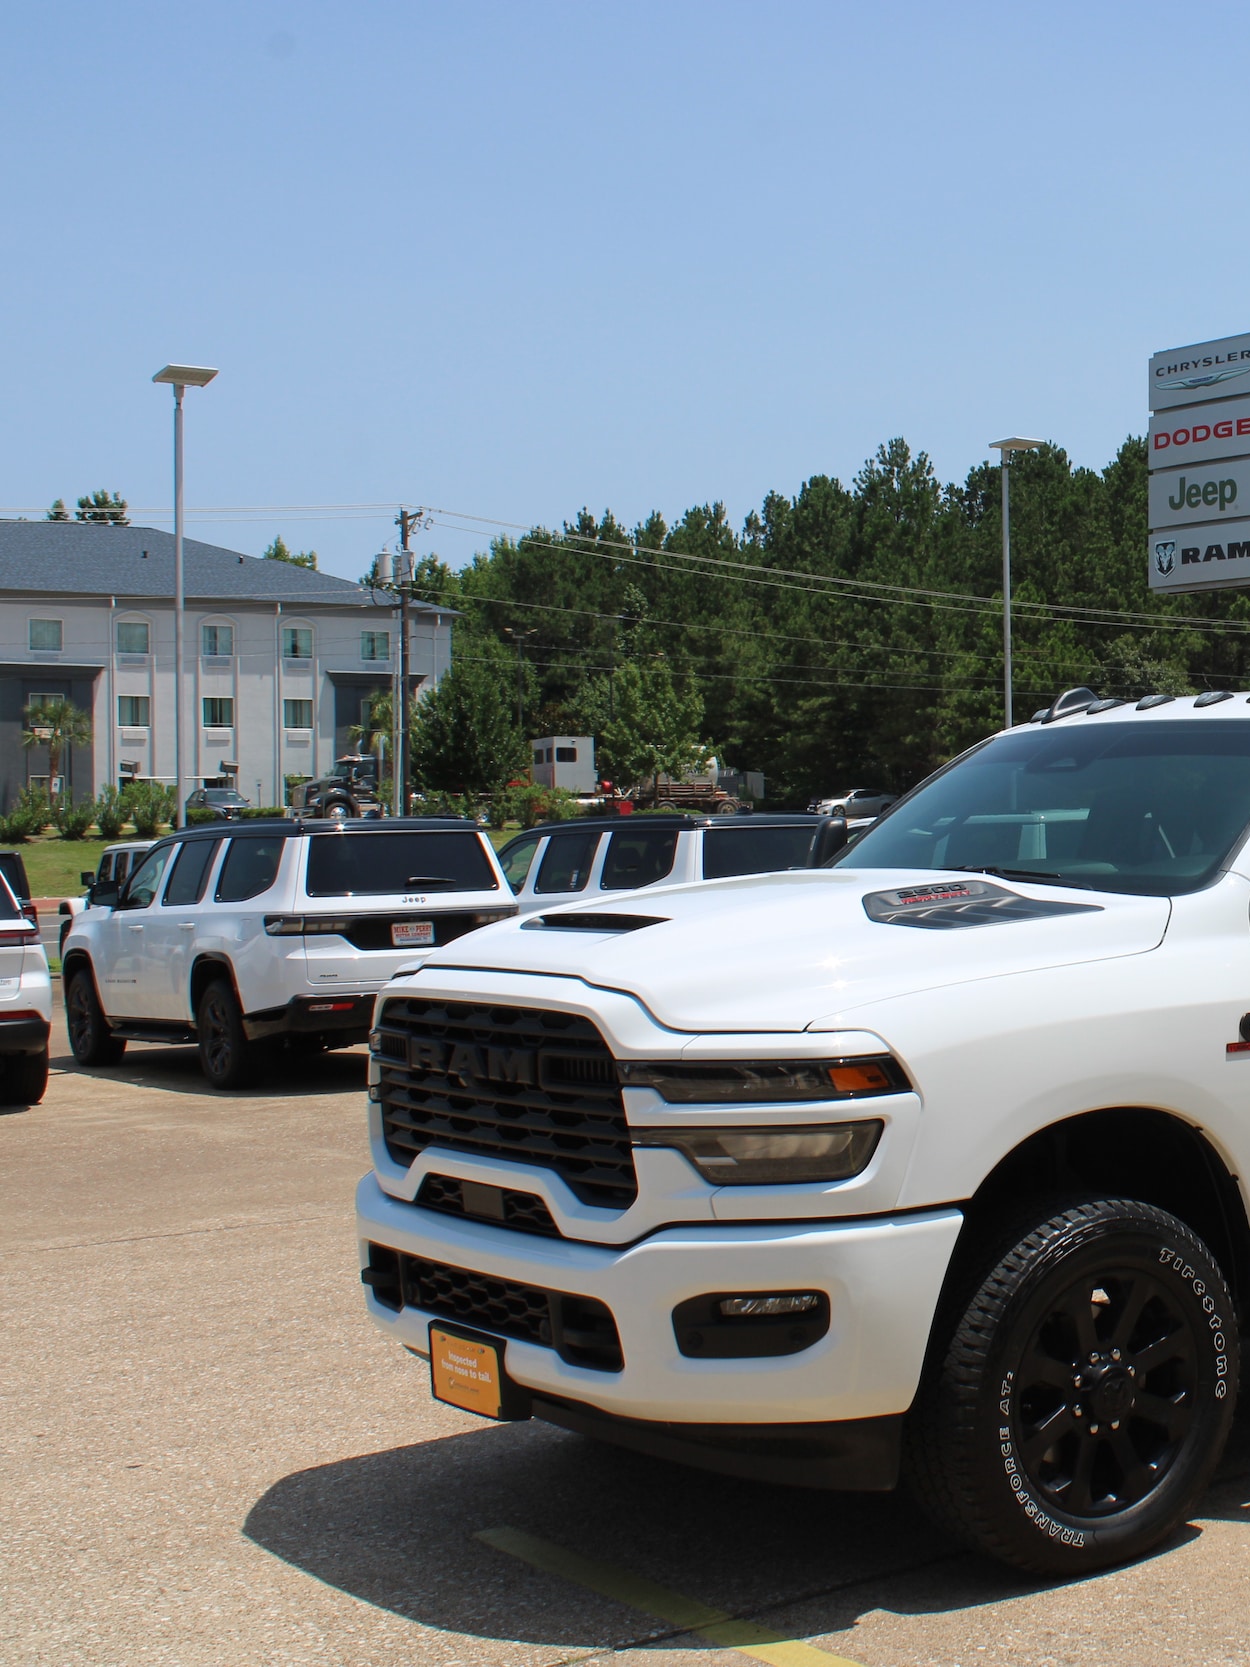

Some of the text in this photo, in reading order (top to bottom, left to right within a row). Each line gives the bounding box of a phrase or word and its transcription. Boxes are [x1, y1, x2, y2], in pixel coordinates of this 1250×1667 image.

[1168, 476, 1237, 512] Jeep
[402, 896, 427, 904] Jeep
[896, 884, 967, 899] 2500
[411, 1036, 534, 1087] RAM
[1159, 1247, 1228, 1400] Firestone
[441, 1358, 454, 1372] from
[454, 1365, 469, 1377] nose
[469, 1368, 477, 1379] to
[448, 1350, 478, 1369] Inspected
[999, 1427, 1085, 1548] TRANSFORCE
